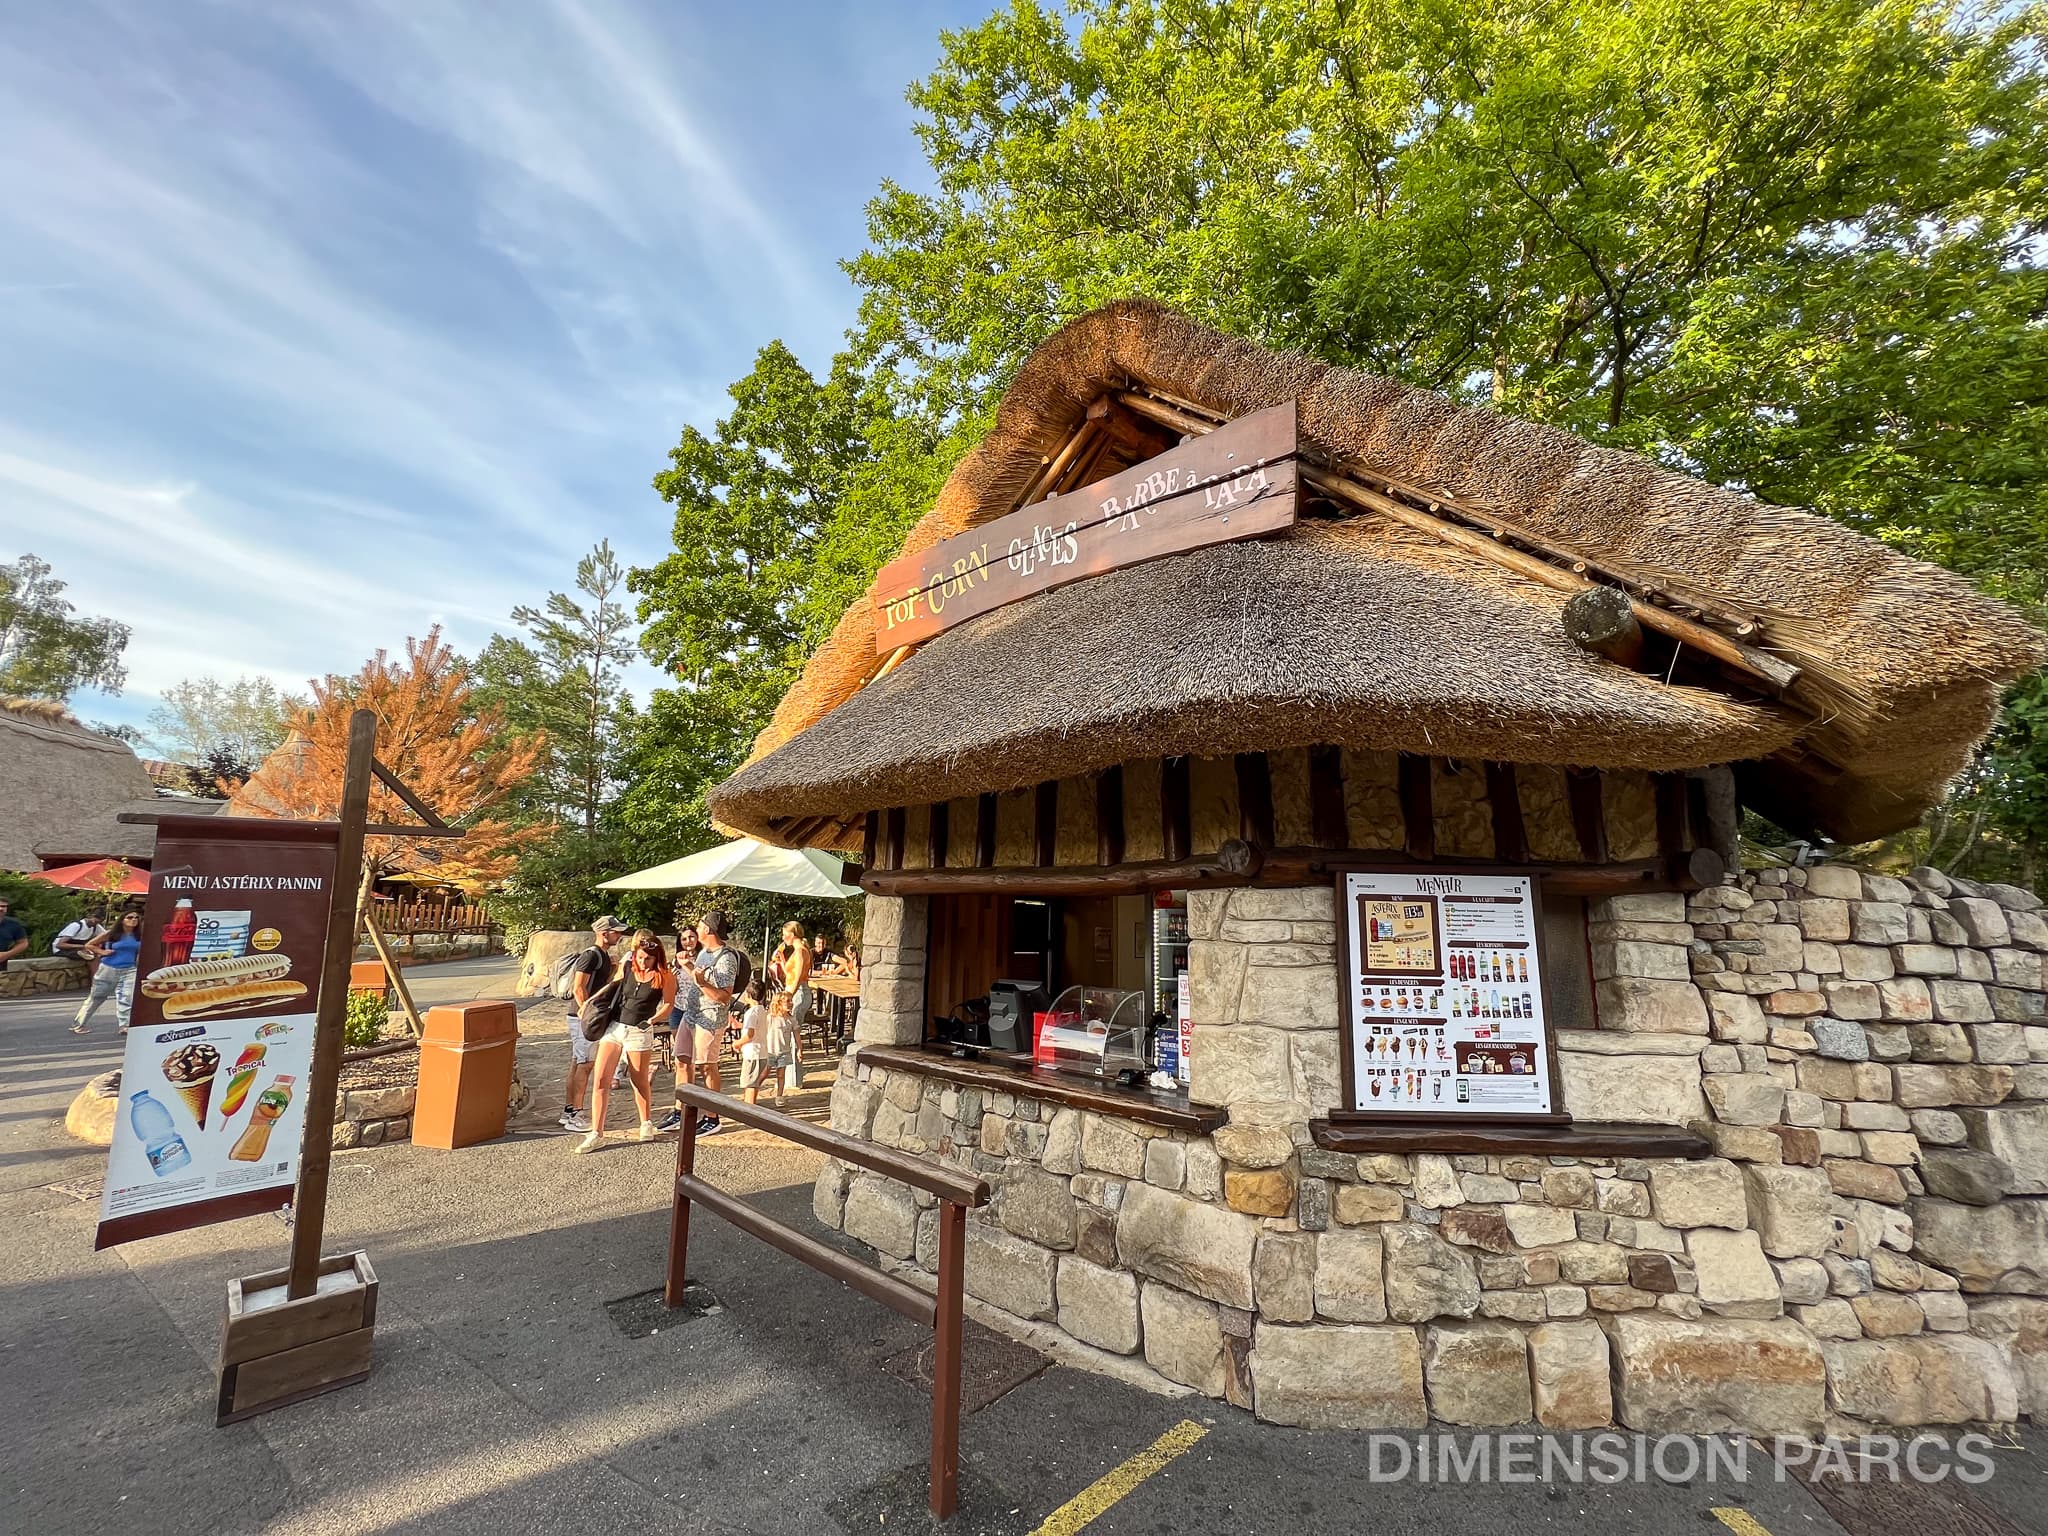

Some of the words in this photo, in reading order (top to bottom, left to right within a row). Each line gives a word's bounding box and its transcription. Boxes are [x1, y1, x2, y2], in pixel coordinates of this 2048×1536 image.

[1007, 520, 1079, 577] GLACES
[1099, 467, 1181, 532] BARBE
[1203, 457, 1268, 511] PAPA
[163, 875, 208, 889] MENU
[211, 874, 274, 889] ASTÉRIX
[277, 877, 322, 890] PANINI
[1416, 877, 1462, 894] MENHIR
[199, 918, 220, 930] SO
[225, 1060, 266, 1077] TROPICAL
